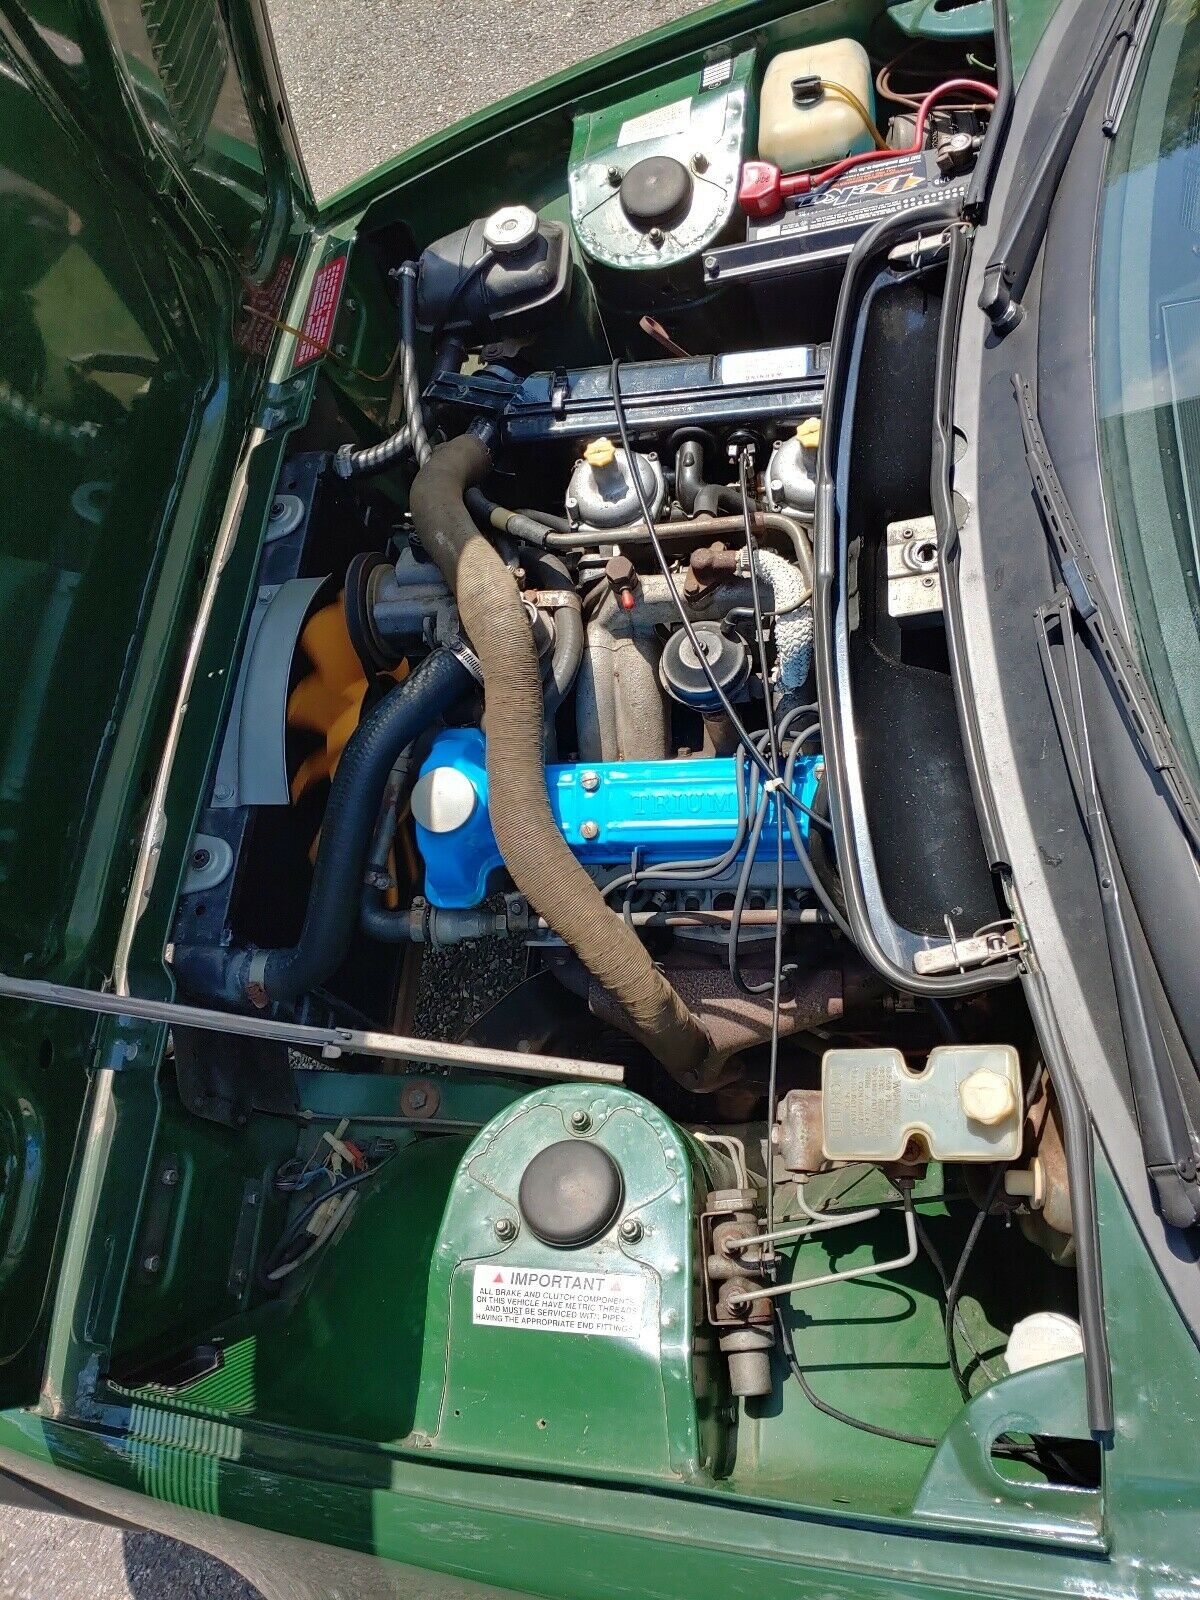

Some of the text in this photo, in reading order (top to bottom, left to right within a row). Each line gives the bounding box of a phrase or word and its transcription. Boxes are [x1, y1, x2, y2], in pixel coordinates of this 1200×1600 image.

[631, 790, 752, 817] TRIUM
[510, 1272, 605, 1292] IMPORTANT
[479, 1287, 493, 1296] ALL
[495, 1289, 522, 1297] BRAKE
[524, 1291, 541, 1299] AND
[543, 1292, 575, 1301] CLUTCH
[485, 1305, 501, 1313] AND
[503, 1306, 522, 1315] MUST
[525, 1308, 535, 1316] BE
[538, 1308, 577, 1319] SERVICED
[603, 1313, 626, 1322] PIPES
[489, 1297, 505, 1305] THIS
[507, 1298, 539, 1307] VEHICLE
[541, 1301, 564, 1309] HAVE
[565, 1302, 596, 1311] METRIC
[598, 1304, 637, 1314] THREADS
[476, 1313, 633, 1332] HAVING THE APPROPRIATE END FITTINGS
